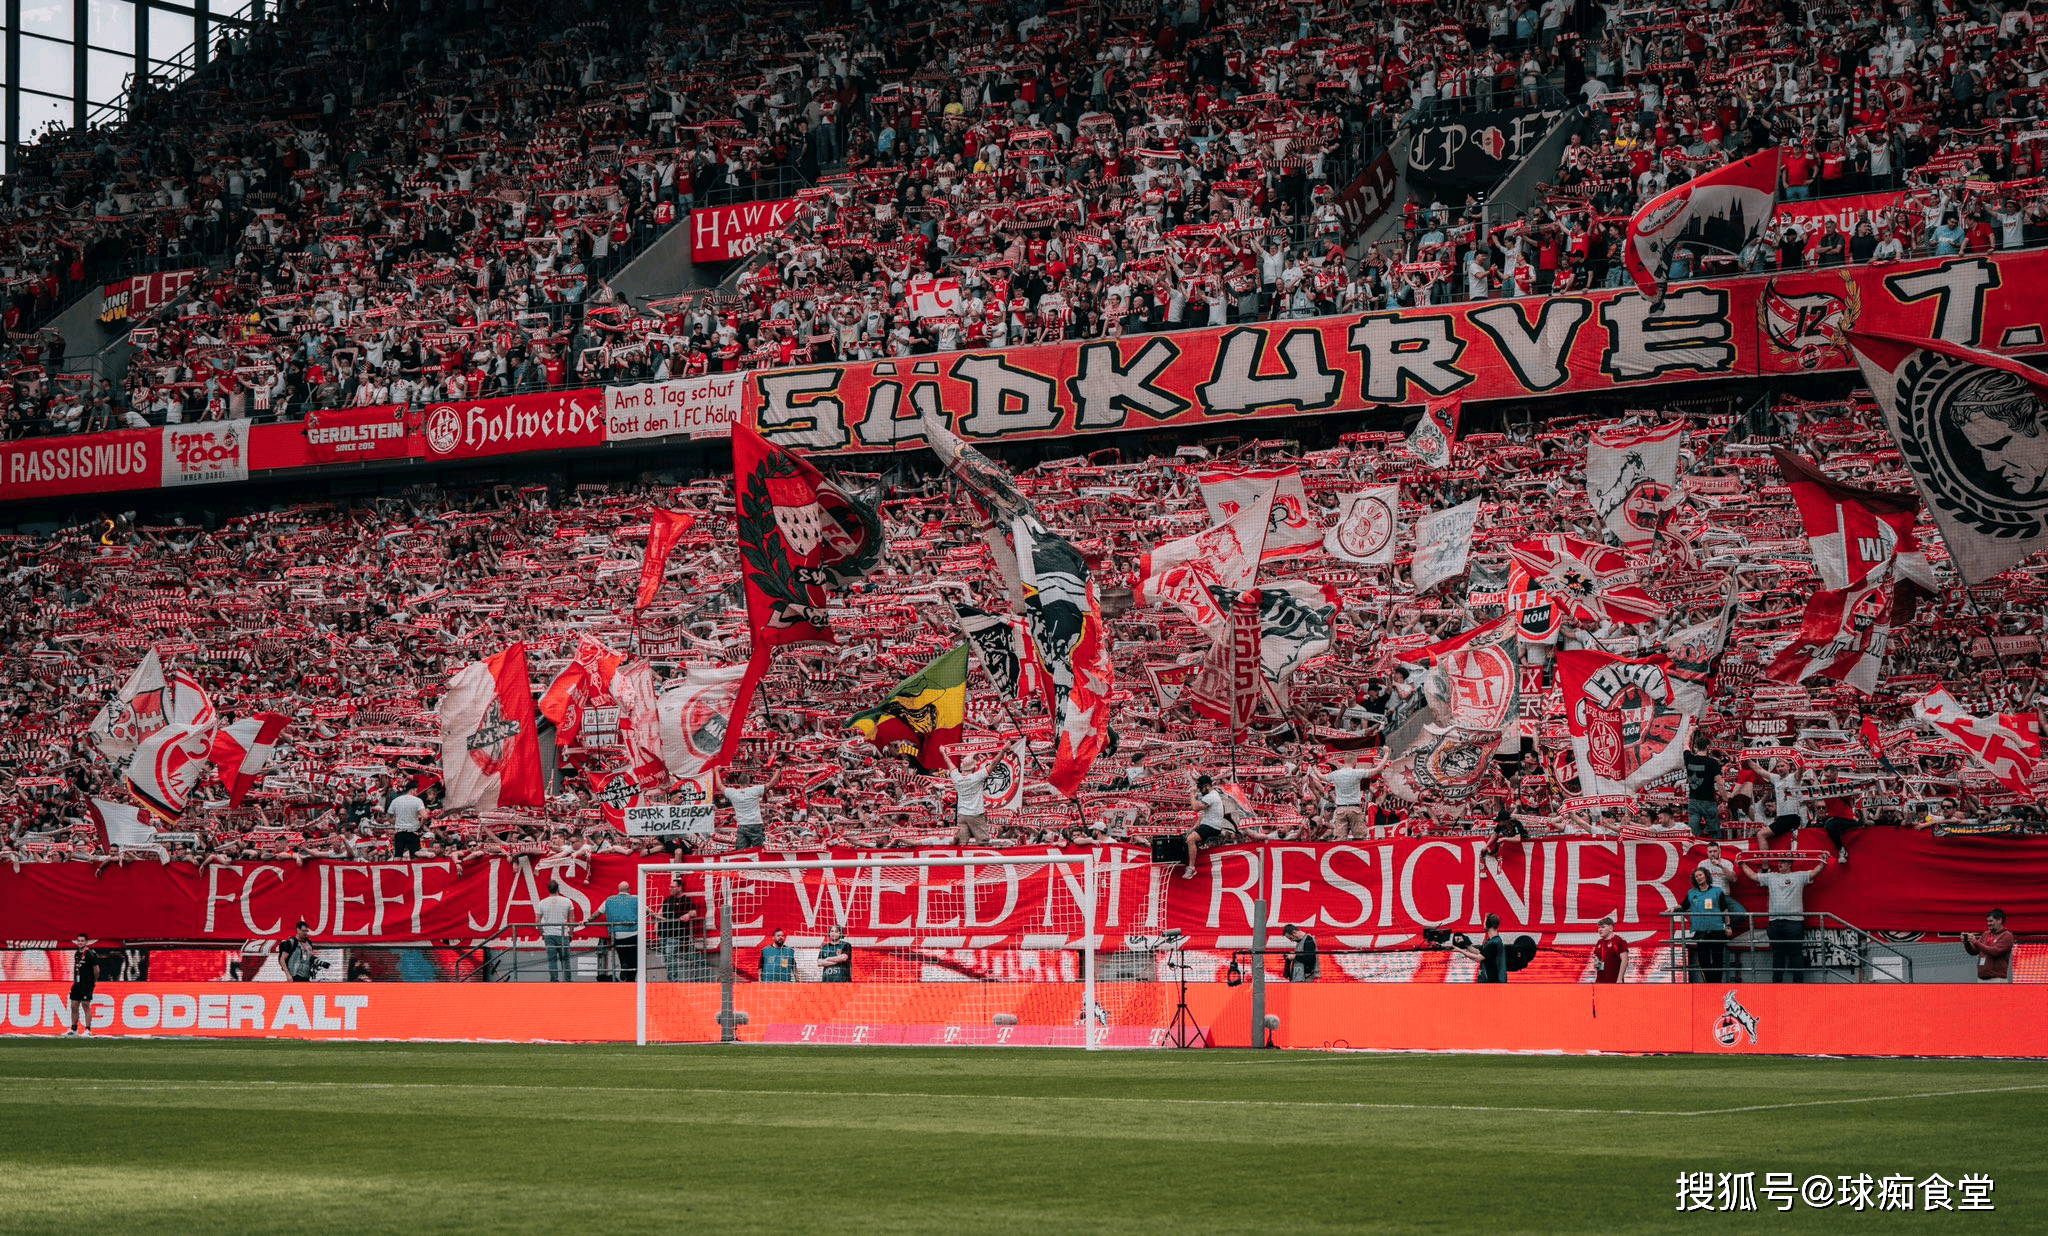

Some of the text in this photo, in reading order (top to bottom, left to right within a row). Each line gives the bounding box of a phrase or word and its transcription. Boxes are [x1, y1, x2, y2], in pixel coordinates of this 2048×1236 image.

[910, 277, 954, 312] FC
[1794, 305, 1829, 338] 12
[756, 284, 1740, 455] SÜDKURVE
[614, 379, 734, 408] Am 8. Tag schuf
[307, 422, 404, 445] GEROLSTEIN
[465, 397, 600, 451] Holweide
[609, 414, 641, 434] Gott
[645, 412, 667, 432] den
[706, 404, 737, 425] Köln
[11, 440, 147, 484] RASSISMUS
[335, 442, 375, 452] SINCE 2012
[1523, 610, 1550, 625] KÖLN
[1602, 796, 1624, 804] 2008
[1808, 784, 1854, 799] PARIS
[628, 806, 714, 820] STARK BLEIBEN
[204, 863, 284, 936] FC
[302, 861, 451, 937] JEFF
[781, 849, 1019, 931] WEED
[122, 993, 266, 1031] ODER
[271, 994, 368, 1031] ALT
